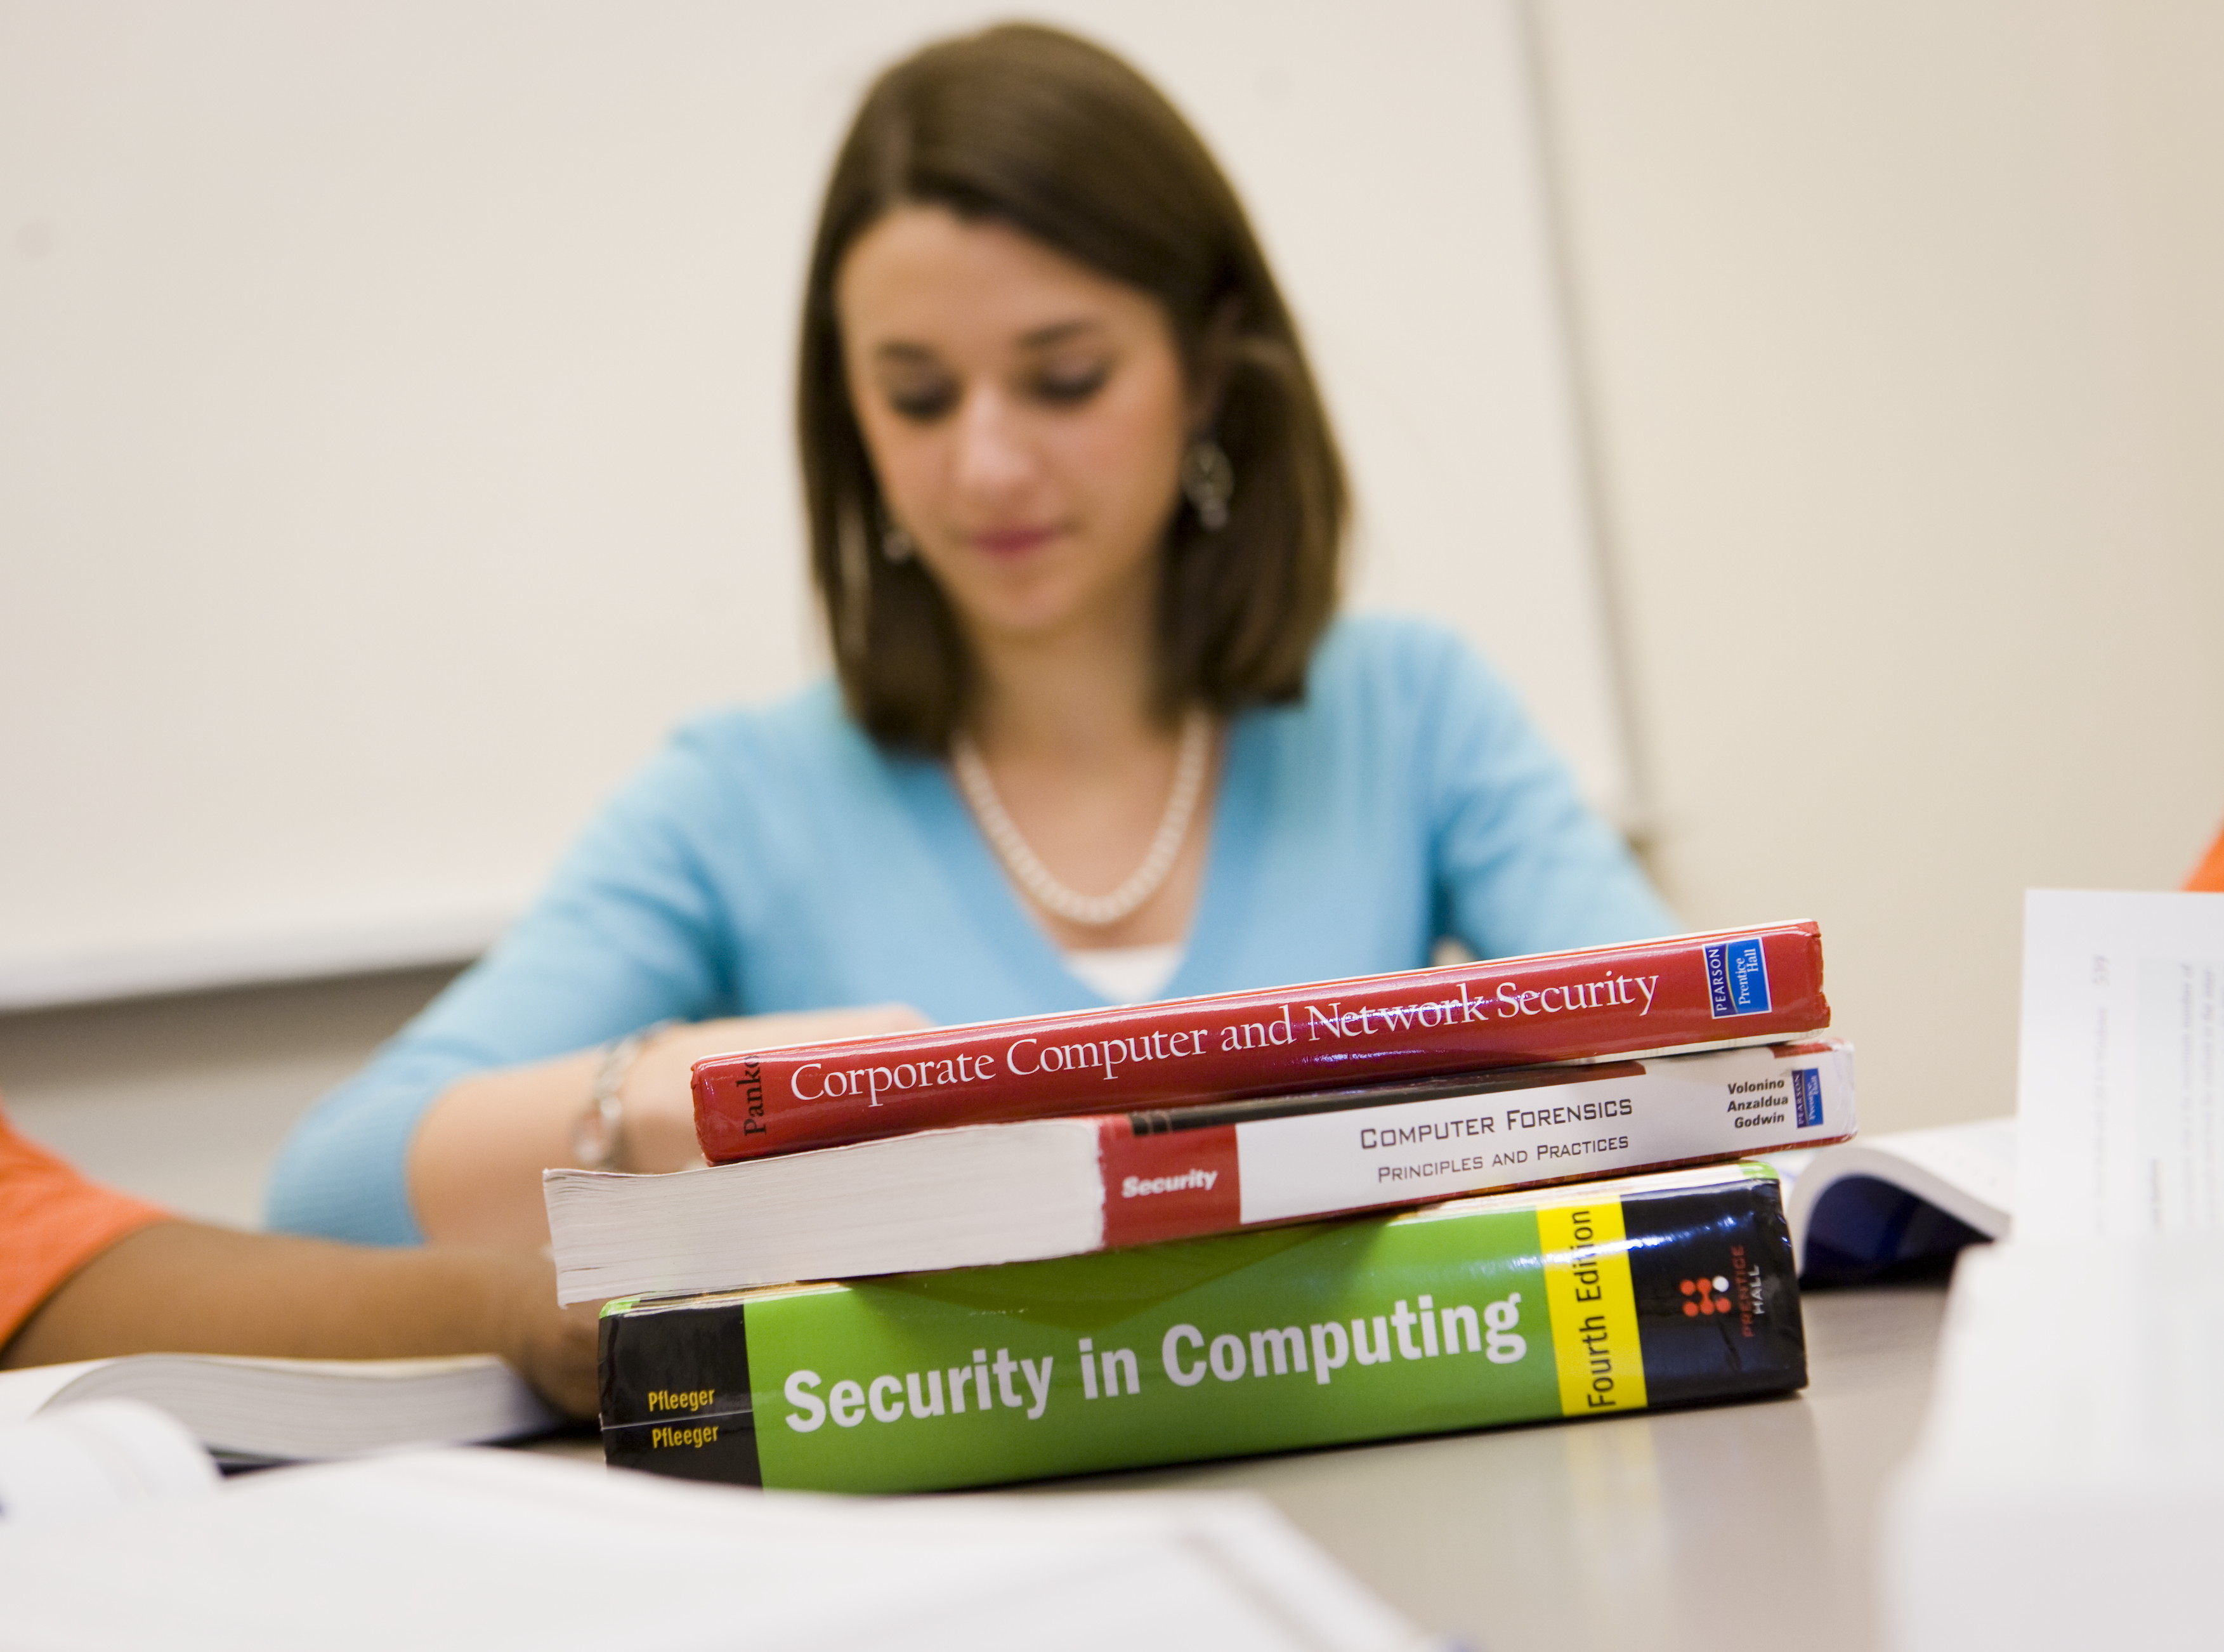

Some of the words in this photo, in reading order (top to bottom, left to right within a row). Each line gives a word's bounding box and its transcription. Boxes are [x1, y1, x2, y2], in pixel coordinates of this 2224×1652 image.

[1708, 948, 1727, 1011] PEARSON
[1735, 958, 1751, 1005] Prentice
[1744, 948, 1759, 971] Hall
[791, 1054, 995, 1106] Corporate
[1007, 1028, 1208, 1080] Computer
[1221, 1004, 1292, 1052] and
[1307, 983, 1488, 1044] Network
[1496, 972, 1659, 1018] Security
[735, 1055, 767, 1136] Panko
[1727, 1078, 1784, 1096] Volonino
[1727, 1094, 1789, 1113] Anzaldua
[1360, 1115, 1494, 1150] COMPUTER
[1506, 1097, 1633, 1131] FORENSICS
[1734, 1112, 1785, 1129] Godwin
[1122, 1168, 1218, 1198] Security
[1377, 1155, 1482, 1184] PRINCIPLES
[1492, 1148, 1529, 1167] AND
[1536, 1135, 1630, 1162] PRACTICES
[1730, 1245, 1754, 1337] PRENTICE
[1748, 1265, 1764, 1314] HALL
[783, 1349, 1054, 1434] Security
[1078, 1338, 1141, 1400] in
[1161, 1292, 1527, 1385] Computing
[1578, 1316, 1616, 1410] Fourth
[648, 1386, 716, 1413] Pfleeger
[651, 1423, 719, 1450] Pfleeger
